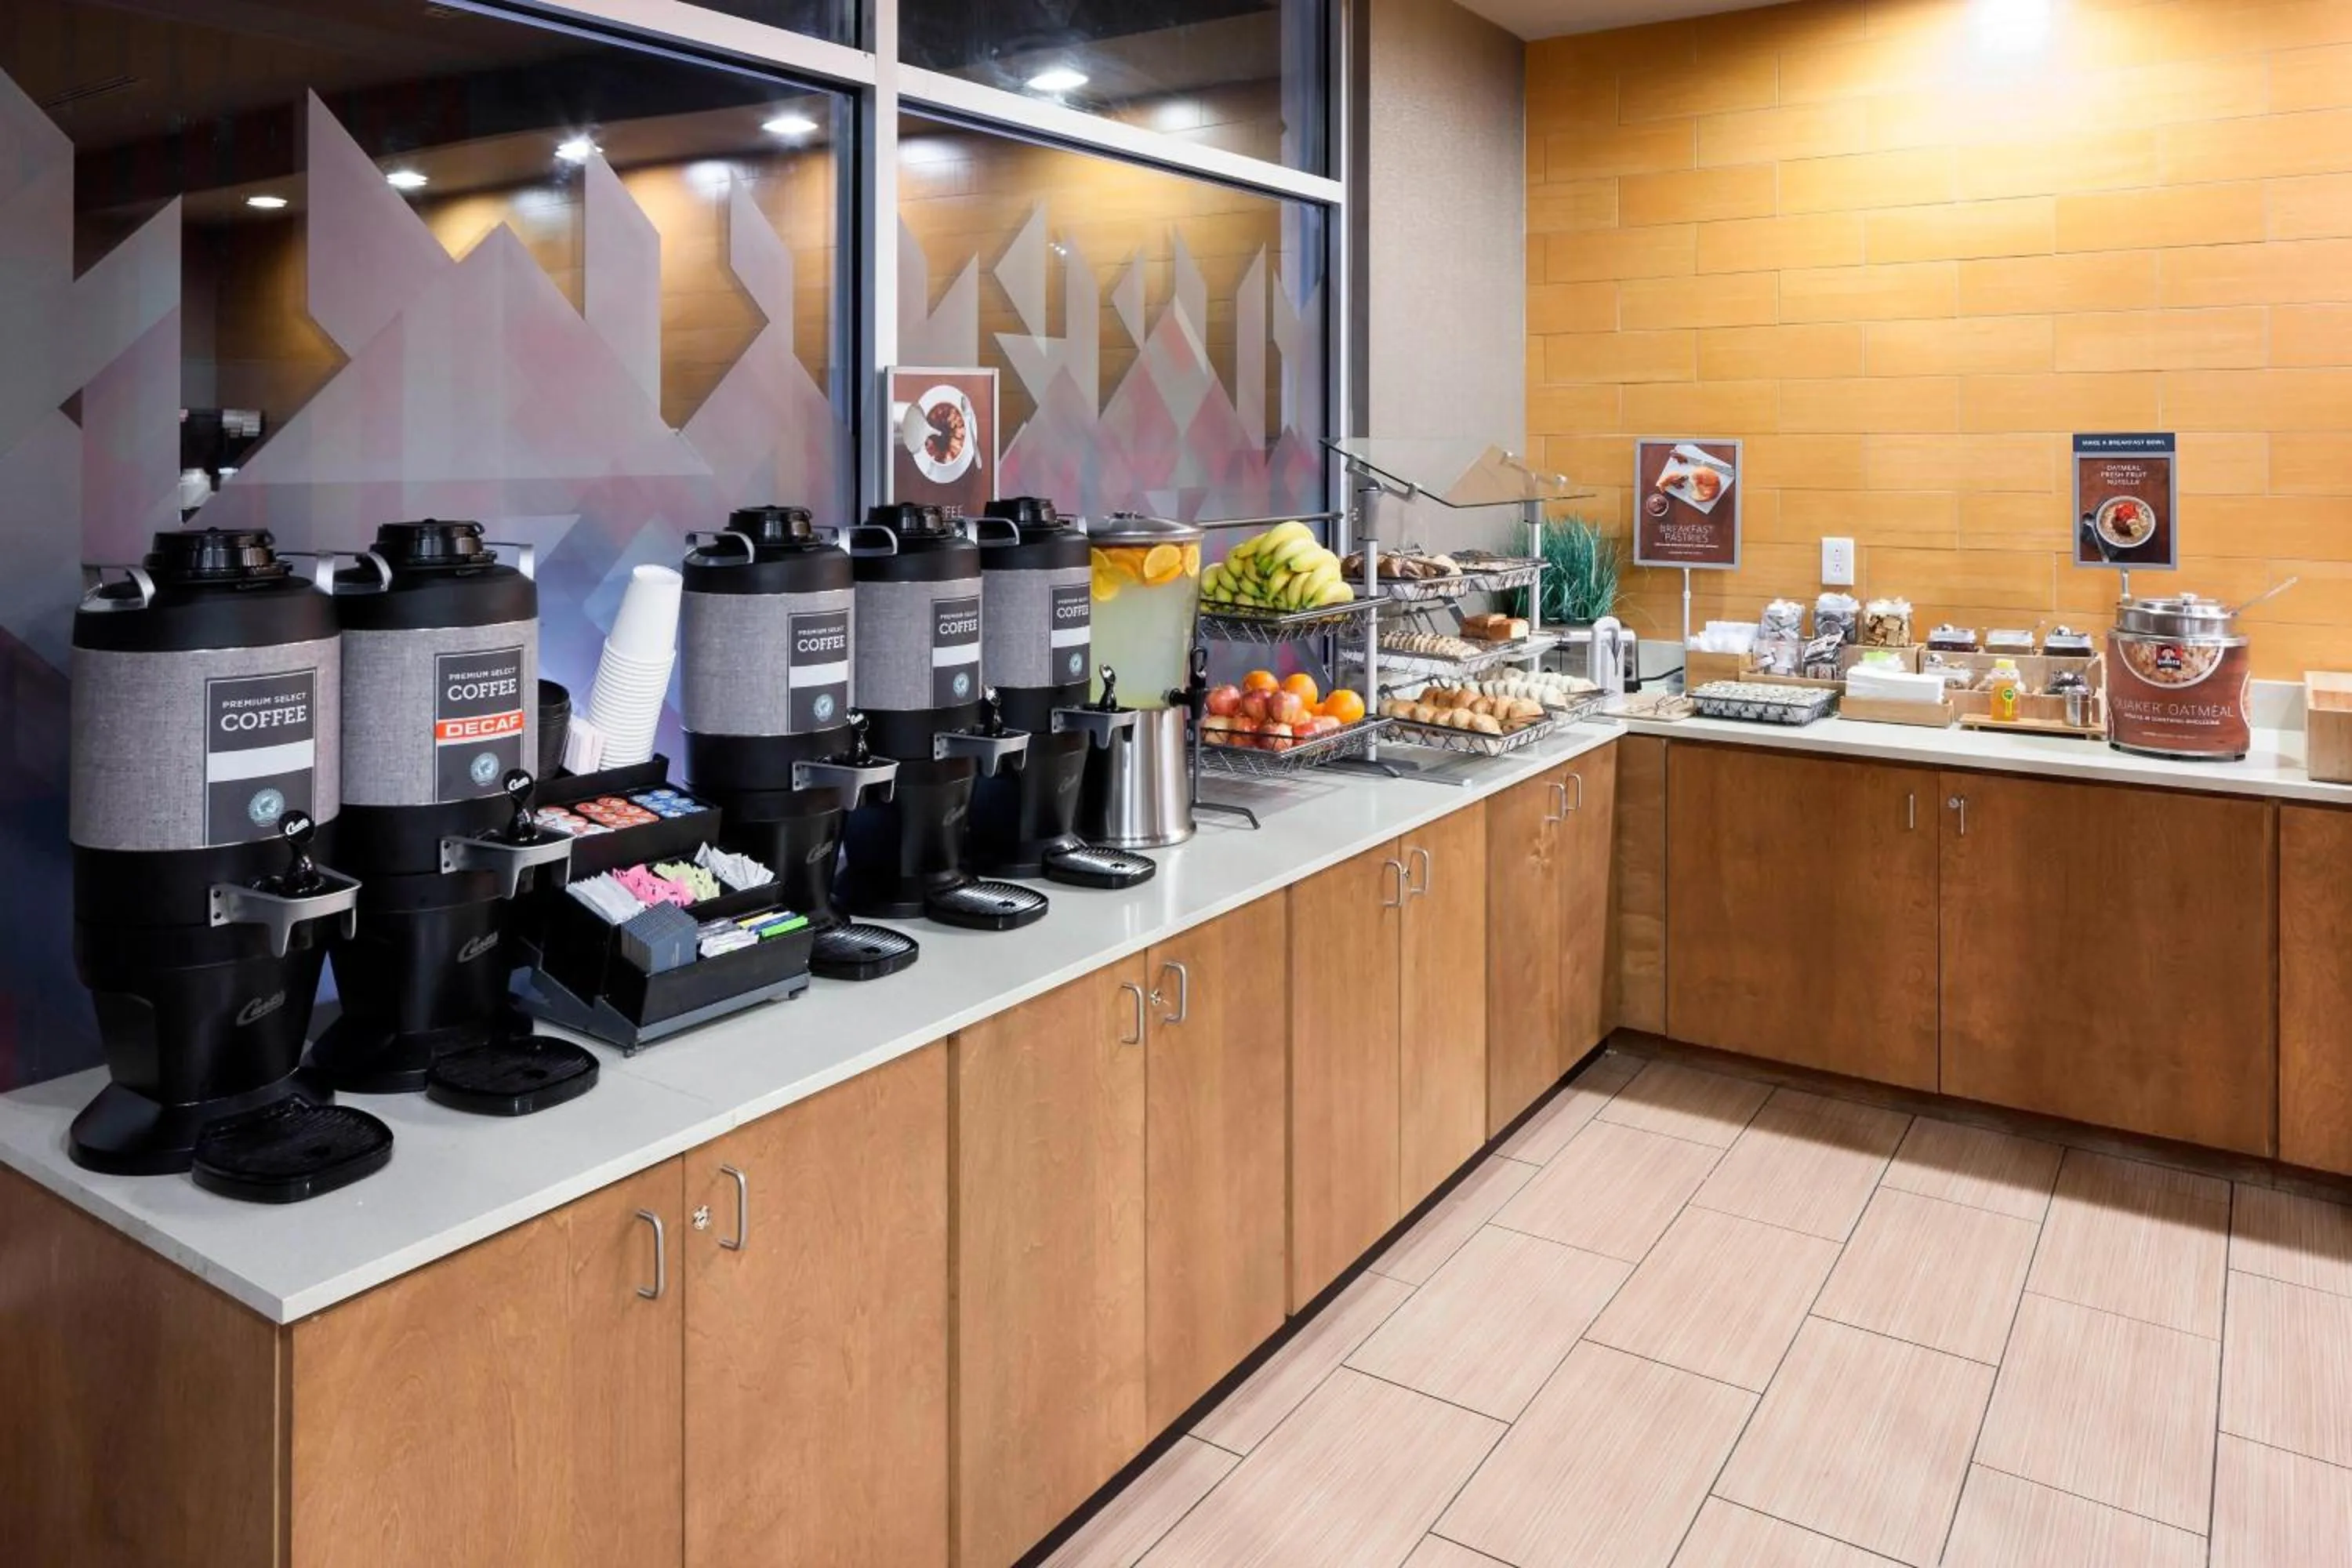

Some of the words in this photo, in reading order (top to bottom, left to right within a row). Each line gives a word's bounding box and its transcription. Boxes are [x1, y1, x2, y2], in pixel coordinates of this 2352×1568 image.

[1660, 524, 1715, 533] BREAKFAST
[938, 619, 978, 634] COFFEE
[797, 634, 845, 652] COFFEE
[448, 670, 489, 681] PREMIUM
[491, 666, 515, 677] SELECT
[448, 678, 517, 701] COFFEE
[222, 697, 272, 709] PREMIUM
[274, 692, 307, 704] SELECT
[220, 705, 307, 731] COFFEE
[2168, 703, 2234, 717] OATMEAL
[445, 714, 520, 737] DECAF
